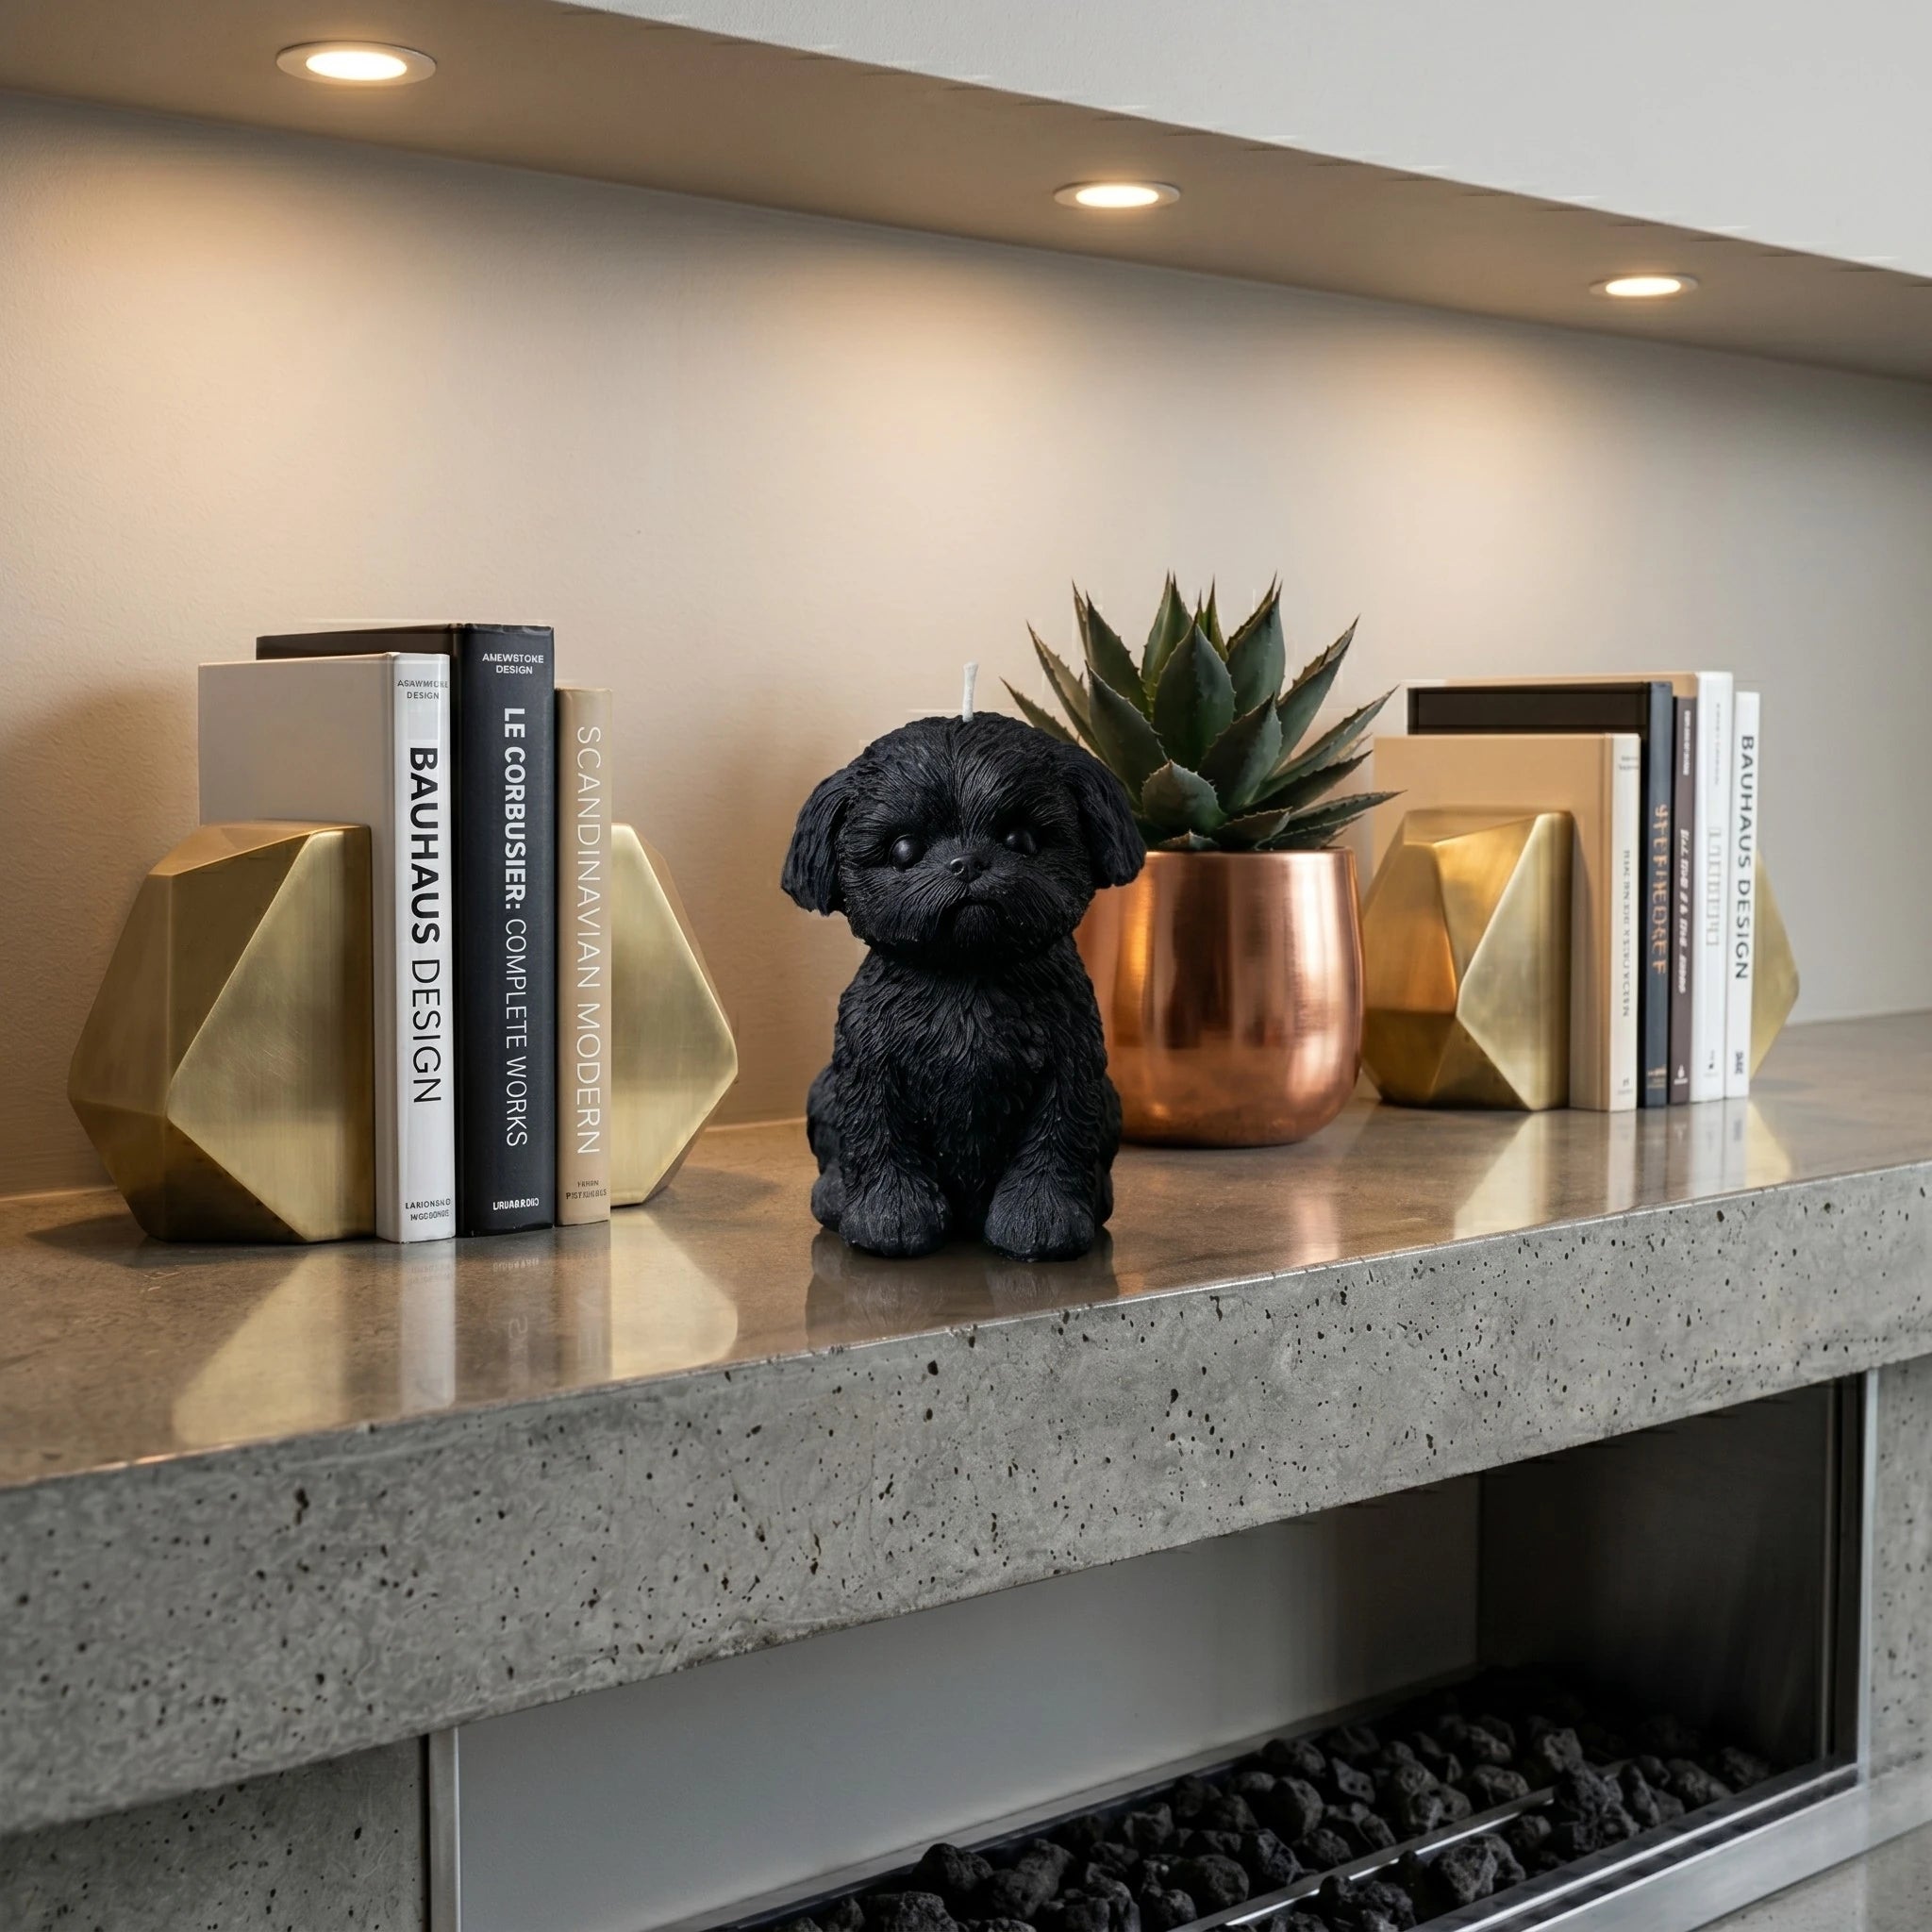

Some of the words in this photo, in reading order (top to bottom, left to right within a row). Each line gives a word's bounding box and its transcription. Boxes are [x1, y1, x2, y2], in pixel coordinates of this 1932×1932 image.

[407, 691, 440, 700] DESIGN
[495, 665, 533, 675] DESIGN
[504, 708, 525, 738] LE
[409, 747, 441, 944] BAUHAUS
[504, 746, 526, 908] CORBUSIER:
[576, 726, 602, 988] SCANDINAVIAN
[1737, 736, 1754, 868] BAUHAUS
[506, 919, 527, 1049] COMPLETE
[1735, 879, 1751, 979] DESIGN
[411, 959, 441, 1103] DESIGN
[576, 1003, 601, 1154] MODERN
[506, 1056, 528, 1147] WORKS
